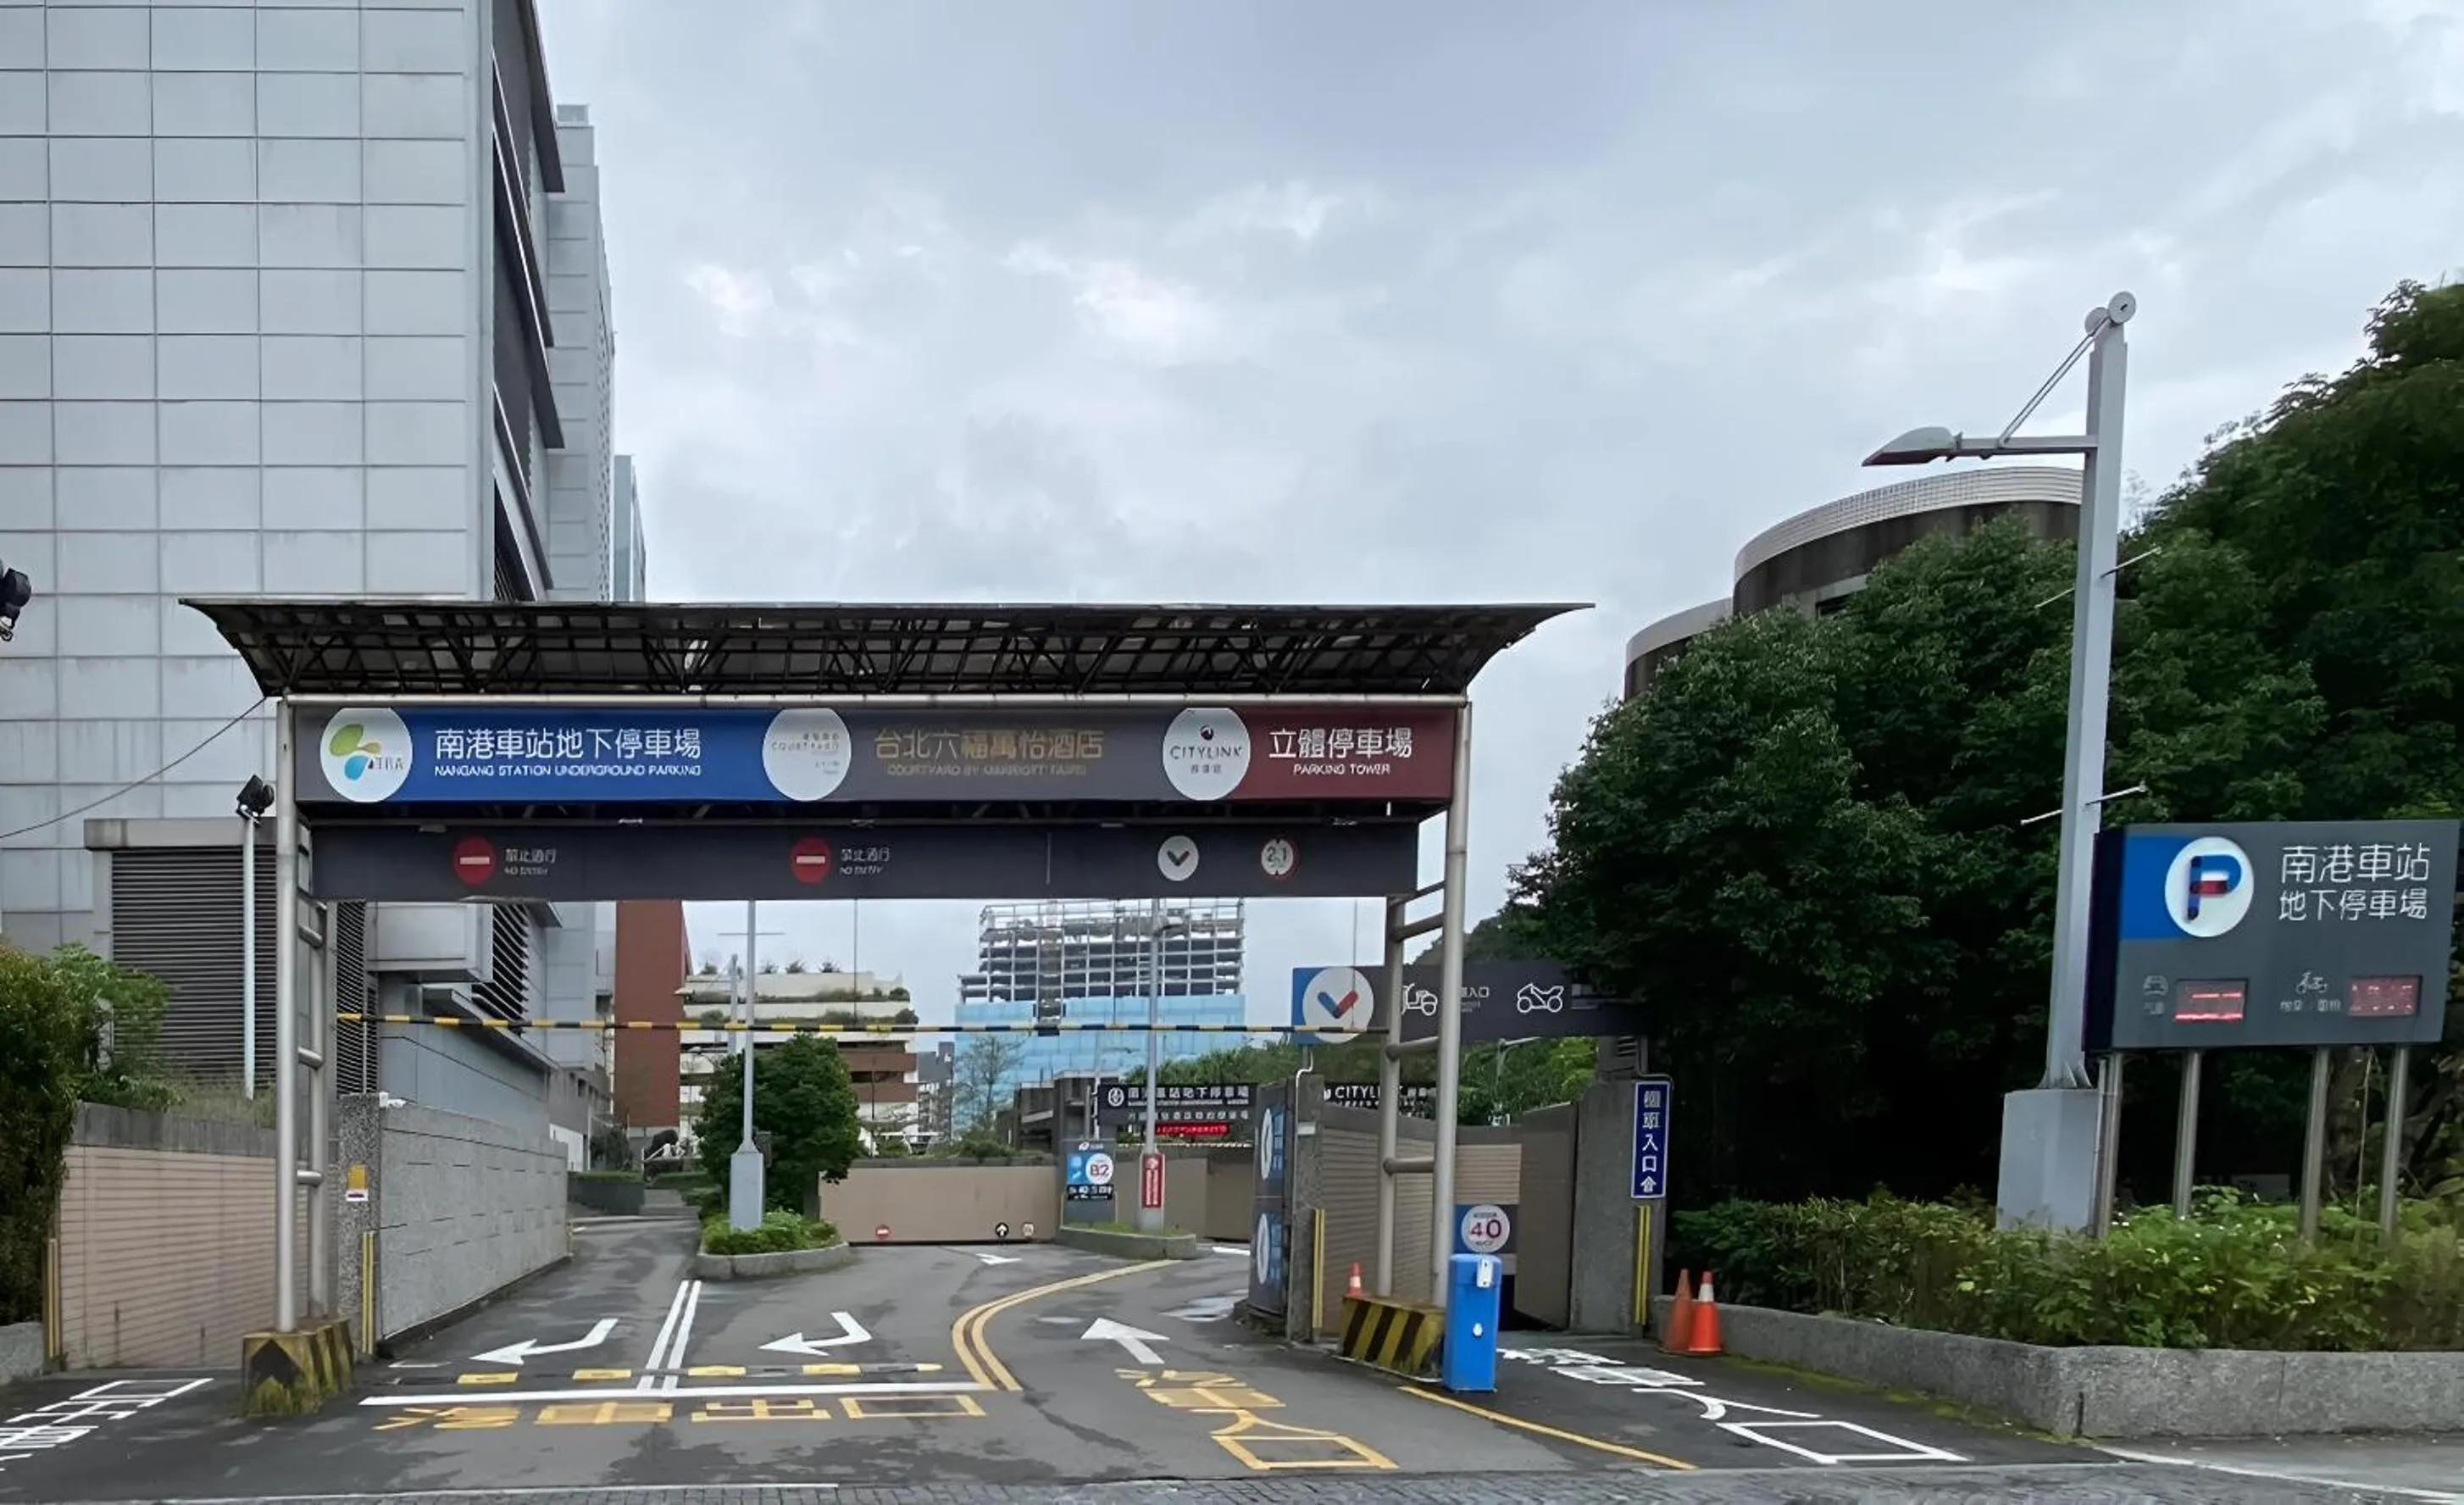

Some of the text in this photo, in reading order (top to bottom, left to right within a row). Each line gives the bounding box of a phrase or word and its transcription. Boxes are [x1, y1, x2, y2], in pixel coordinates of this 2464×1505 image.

[435, 727, 701, 760] 南港車站地下停車場
[874, 728, 1105, 760] 台北六福萬怡酒店
[1268, 727, 1412, 760] 立體停車場
[434, 764, 702, 777] NANGANG STATION UNDERGROUND PARKING
[1293, 763, 1391, 775] PARKING TOWER
[2280, 841, 2432, 884] 南港車站
[2278, 887, 2428, 922] 地下停車場
[1470, 1218, 1502, 1239] 40
